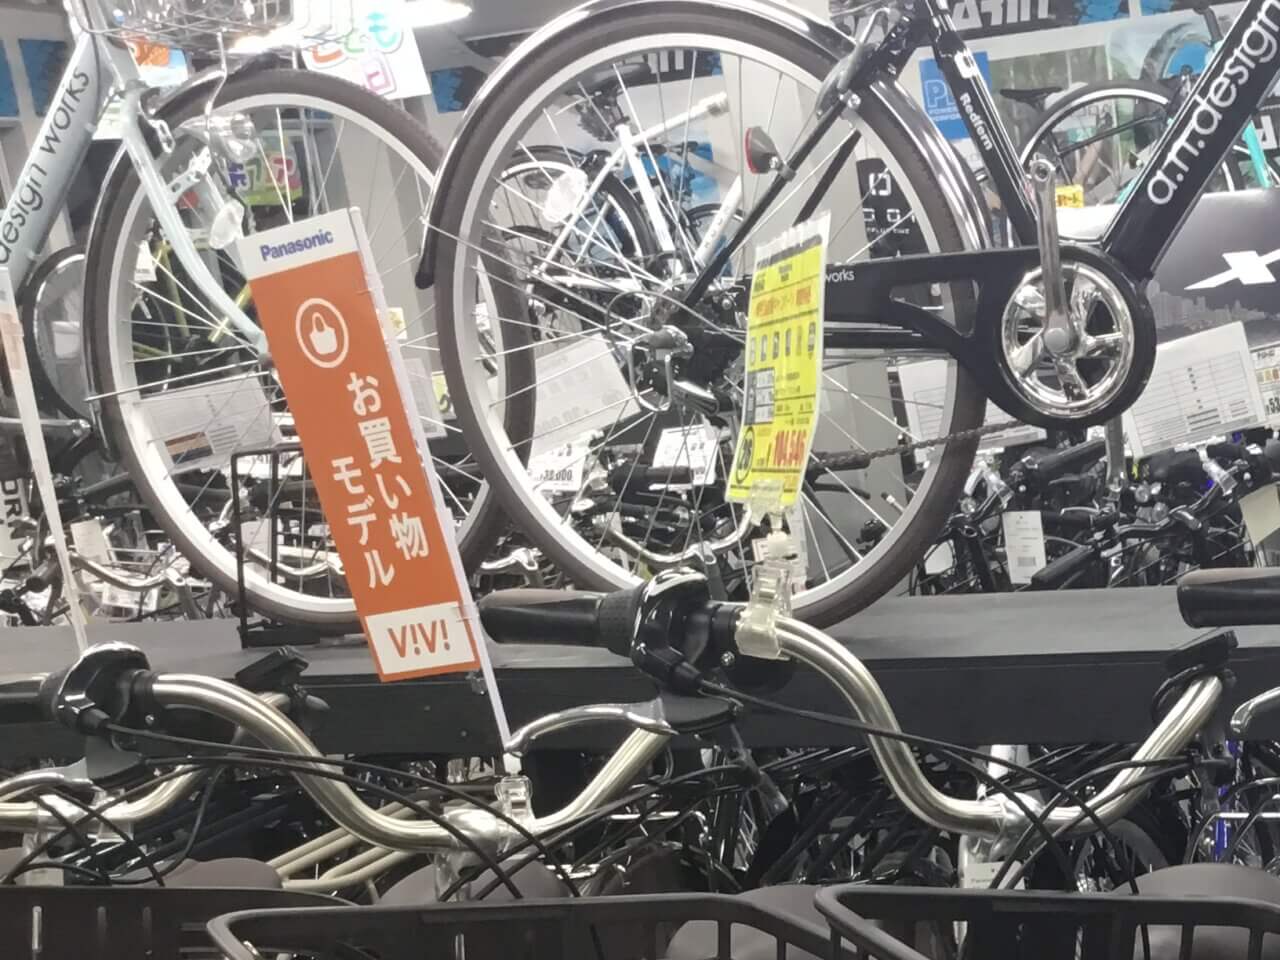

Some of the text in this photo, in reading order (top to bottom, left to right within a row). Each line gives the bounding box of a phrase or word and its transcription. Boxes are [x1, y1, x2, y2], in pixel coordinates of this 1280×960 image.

[40, 70, 90, 154] works
[960, 92, 993, 151] Redfern
[260, 228, 335, 262] Panasonic
[347, 372, 430, 561] お買い物
[331, 456, 394, 589] モデル
